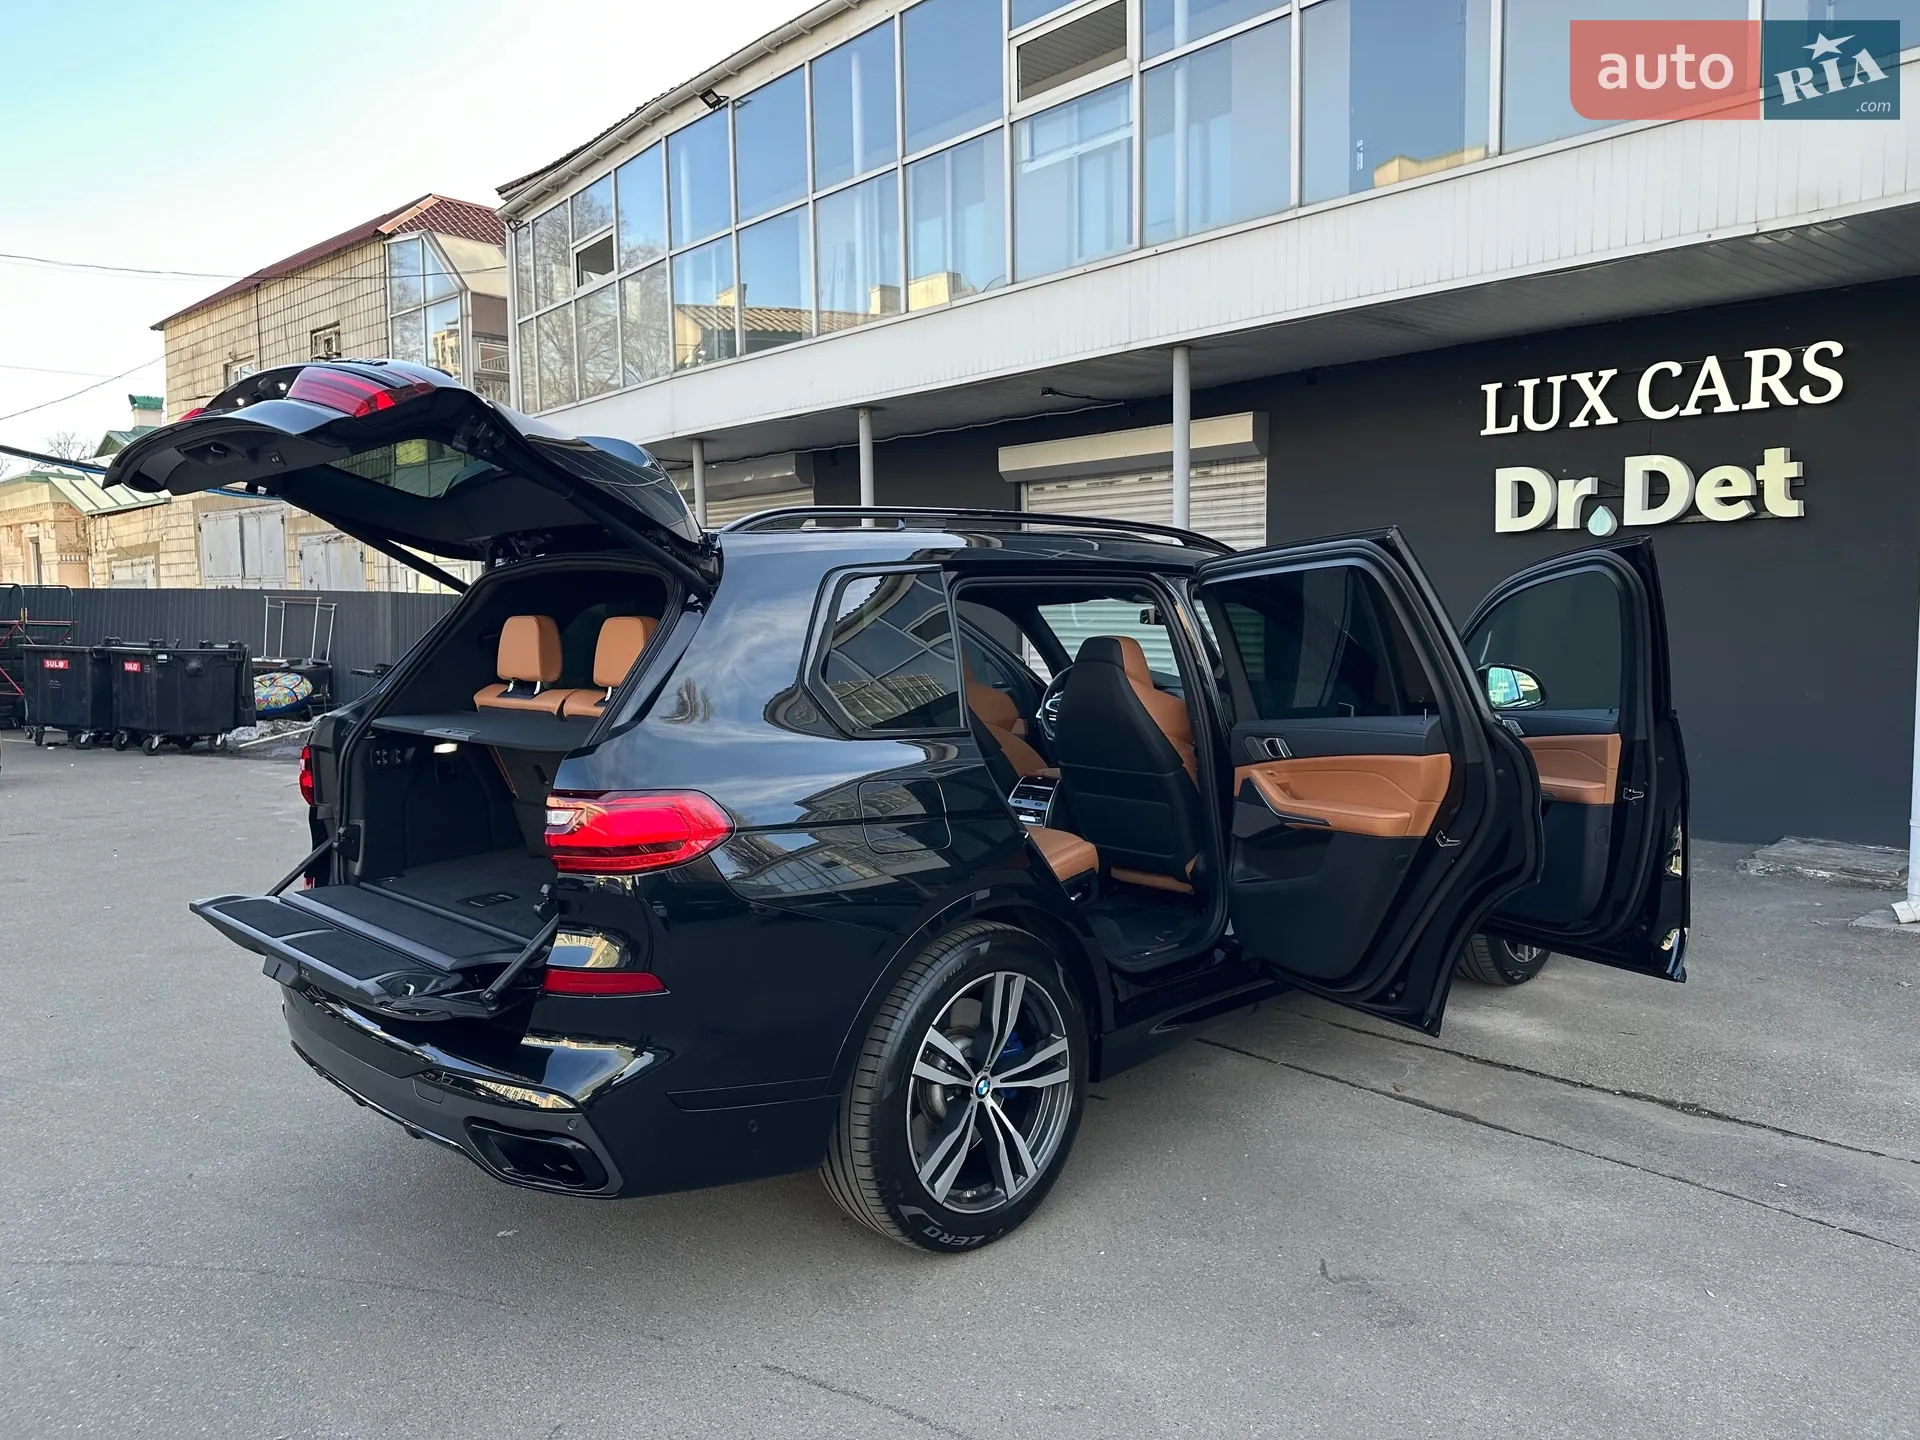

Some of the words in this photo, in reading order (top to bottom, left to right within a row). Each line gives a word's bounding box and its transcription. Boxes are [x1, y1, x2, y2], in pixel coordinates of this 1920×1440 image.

[1480, 369, 1618, 436] LUX
[1637, 340, 1844, 420] CARS
[45, 660, 65, 669] SULO
[125, 662, 139, 671] SULO
[922, 1225, 986, 1246] ZERO
